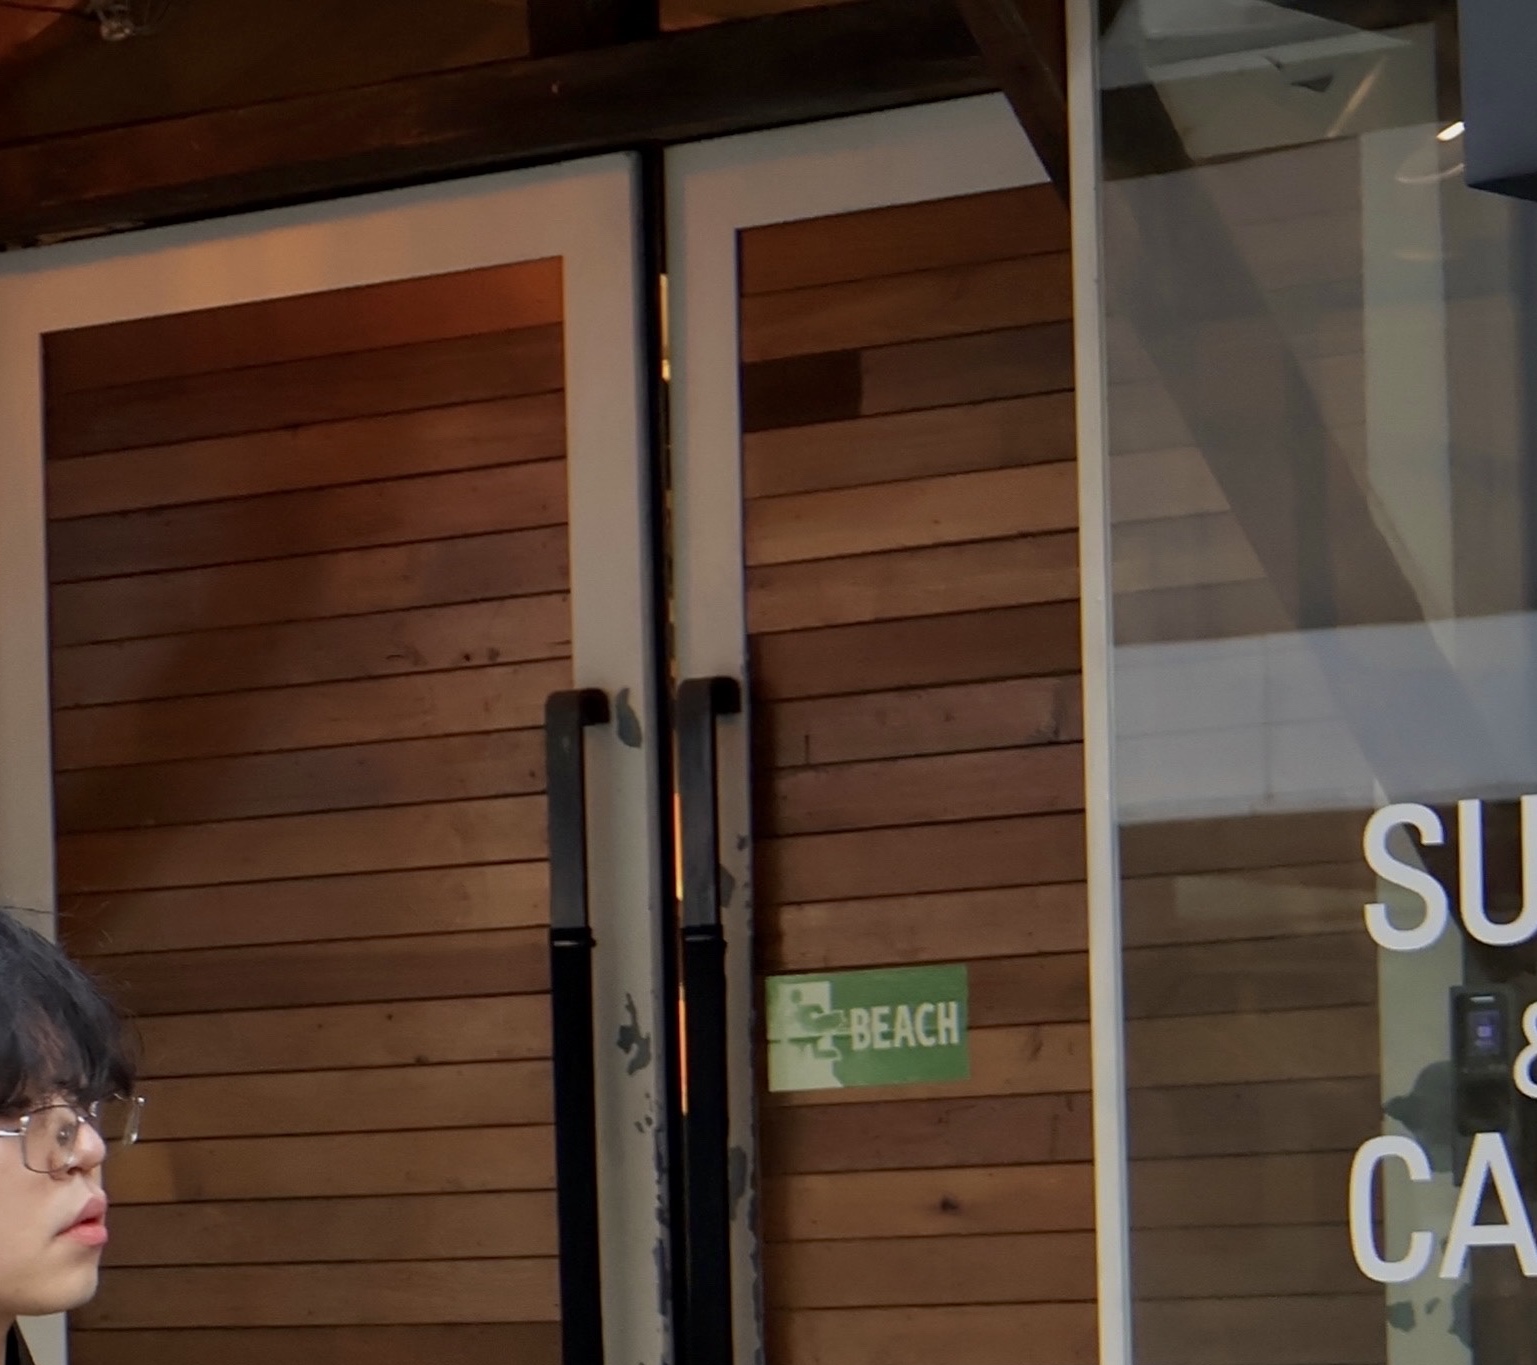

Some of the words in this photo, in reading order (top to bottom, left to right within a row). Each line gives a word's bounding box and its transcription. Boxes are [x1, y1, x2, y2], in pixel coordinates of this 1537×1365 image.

[1363, 795, 1537, 950] SU
[850, 1001, 960, 1051] BEACH
[1349, 1132, 1537, 1283] CA
